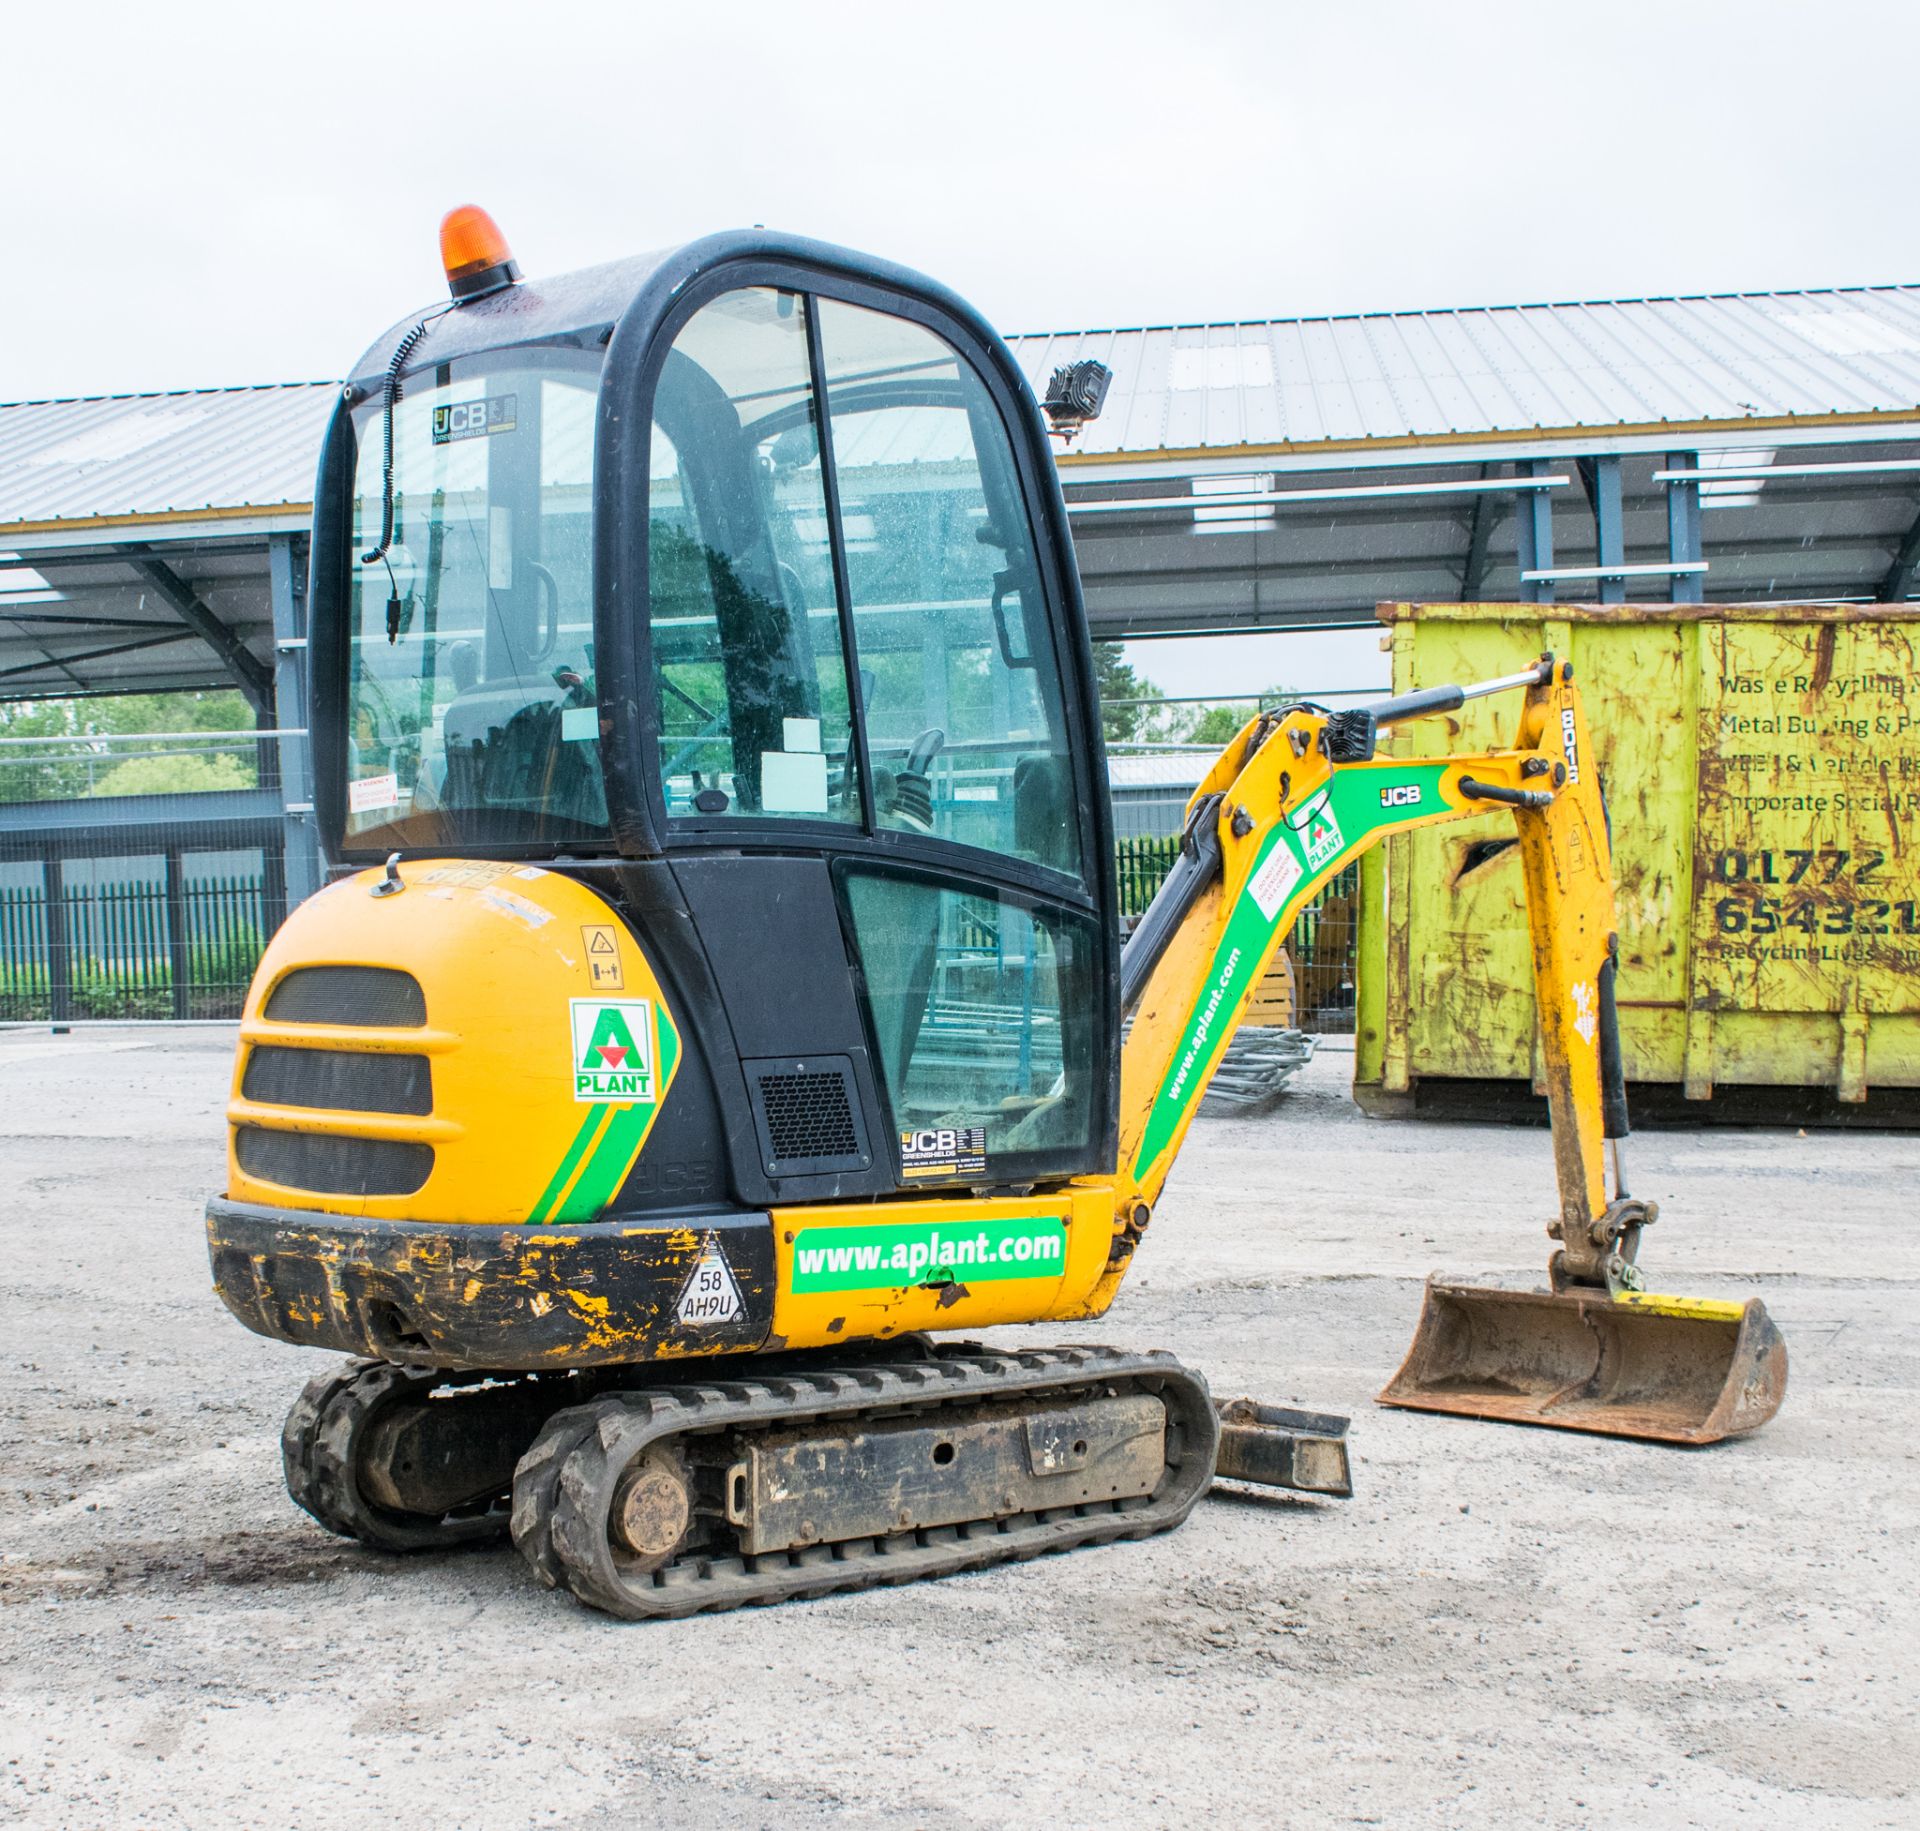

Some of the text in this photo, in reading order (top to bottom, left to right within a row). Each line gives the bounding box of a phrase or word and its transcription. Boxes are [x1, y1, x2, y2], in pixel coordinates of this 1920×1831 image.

[435, 403, 486, 434] JCB
[1719, 676, 1787, 694] Wase
[1720, 715, 1920, 738] Metal Buing & P
[1786, 755, 1801, 772] &
[1381, 785, 1420, 807] JCB
[1721, 794, 1828, 814] orporate
[1308, 807, 1334, 849] A
[1309, 834, 1341, 866] PLANT
[1714, 849, 1885, 884] 01772
[1715, 898, 1920, 935] 654321
[1168, 947, 1242, 1100] www.aplant.com
[582, 1008, 644, 1069] A
[576, 1075, 650, 1093] PLANT
[902, 1130, 956, 1153] JCB
[902, 1150, 956, 1160] GREENSHIELDS
[634, 1160, 713, 1193] JCB
[798, 1232, 1061, 1278] www.aplant.com
[700, 1271, 722, 1292] 58
[684, 1295, 731, 1317] AH9U
